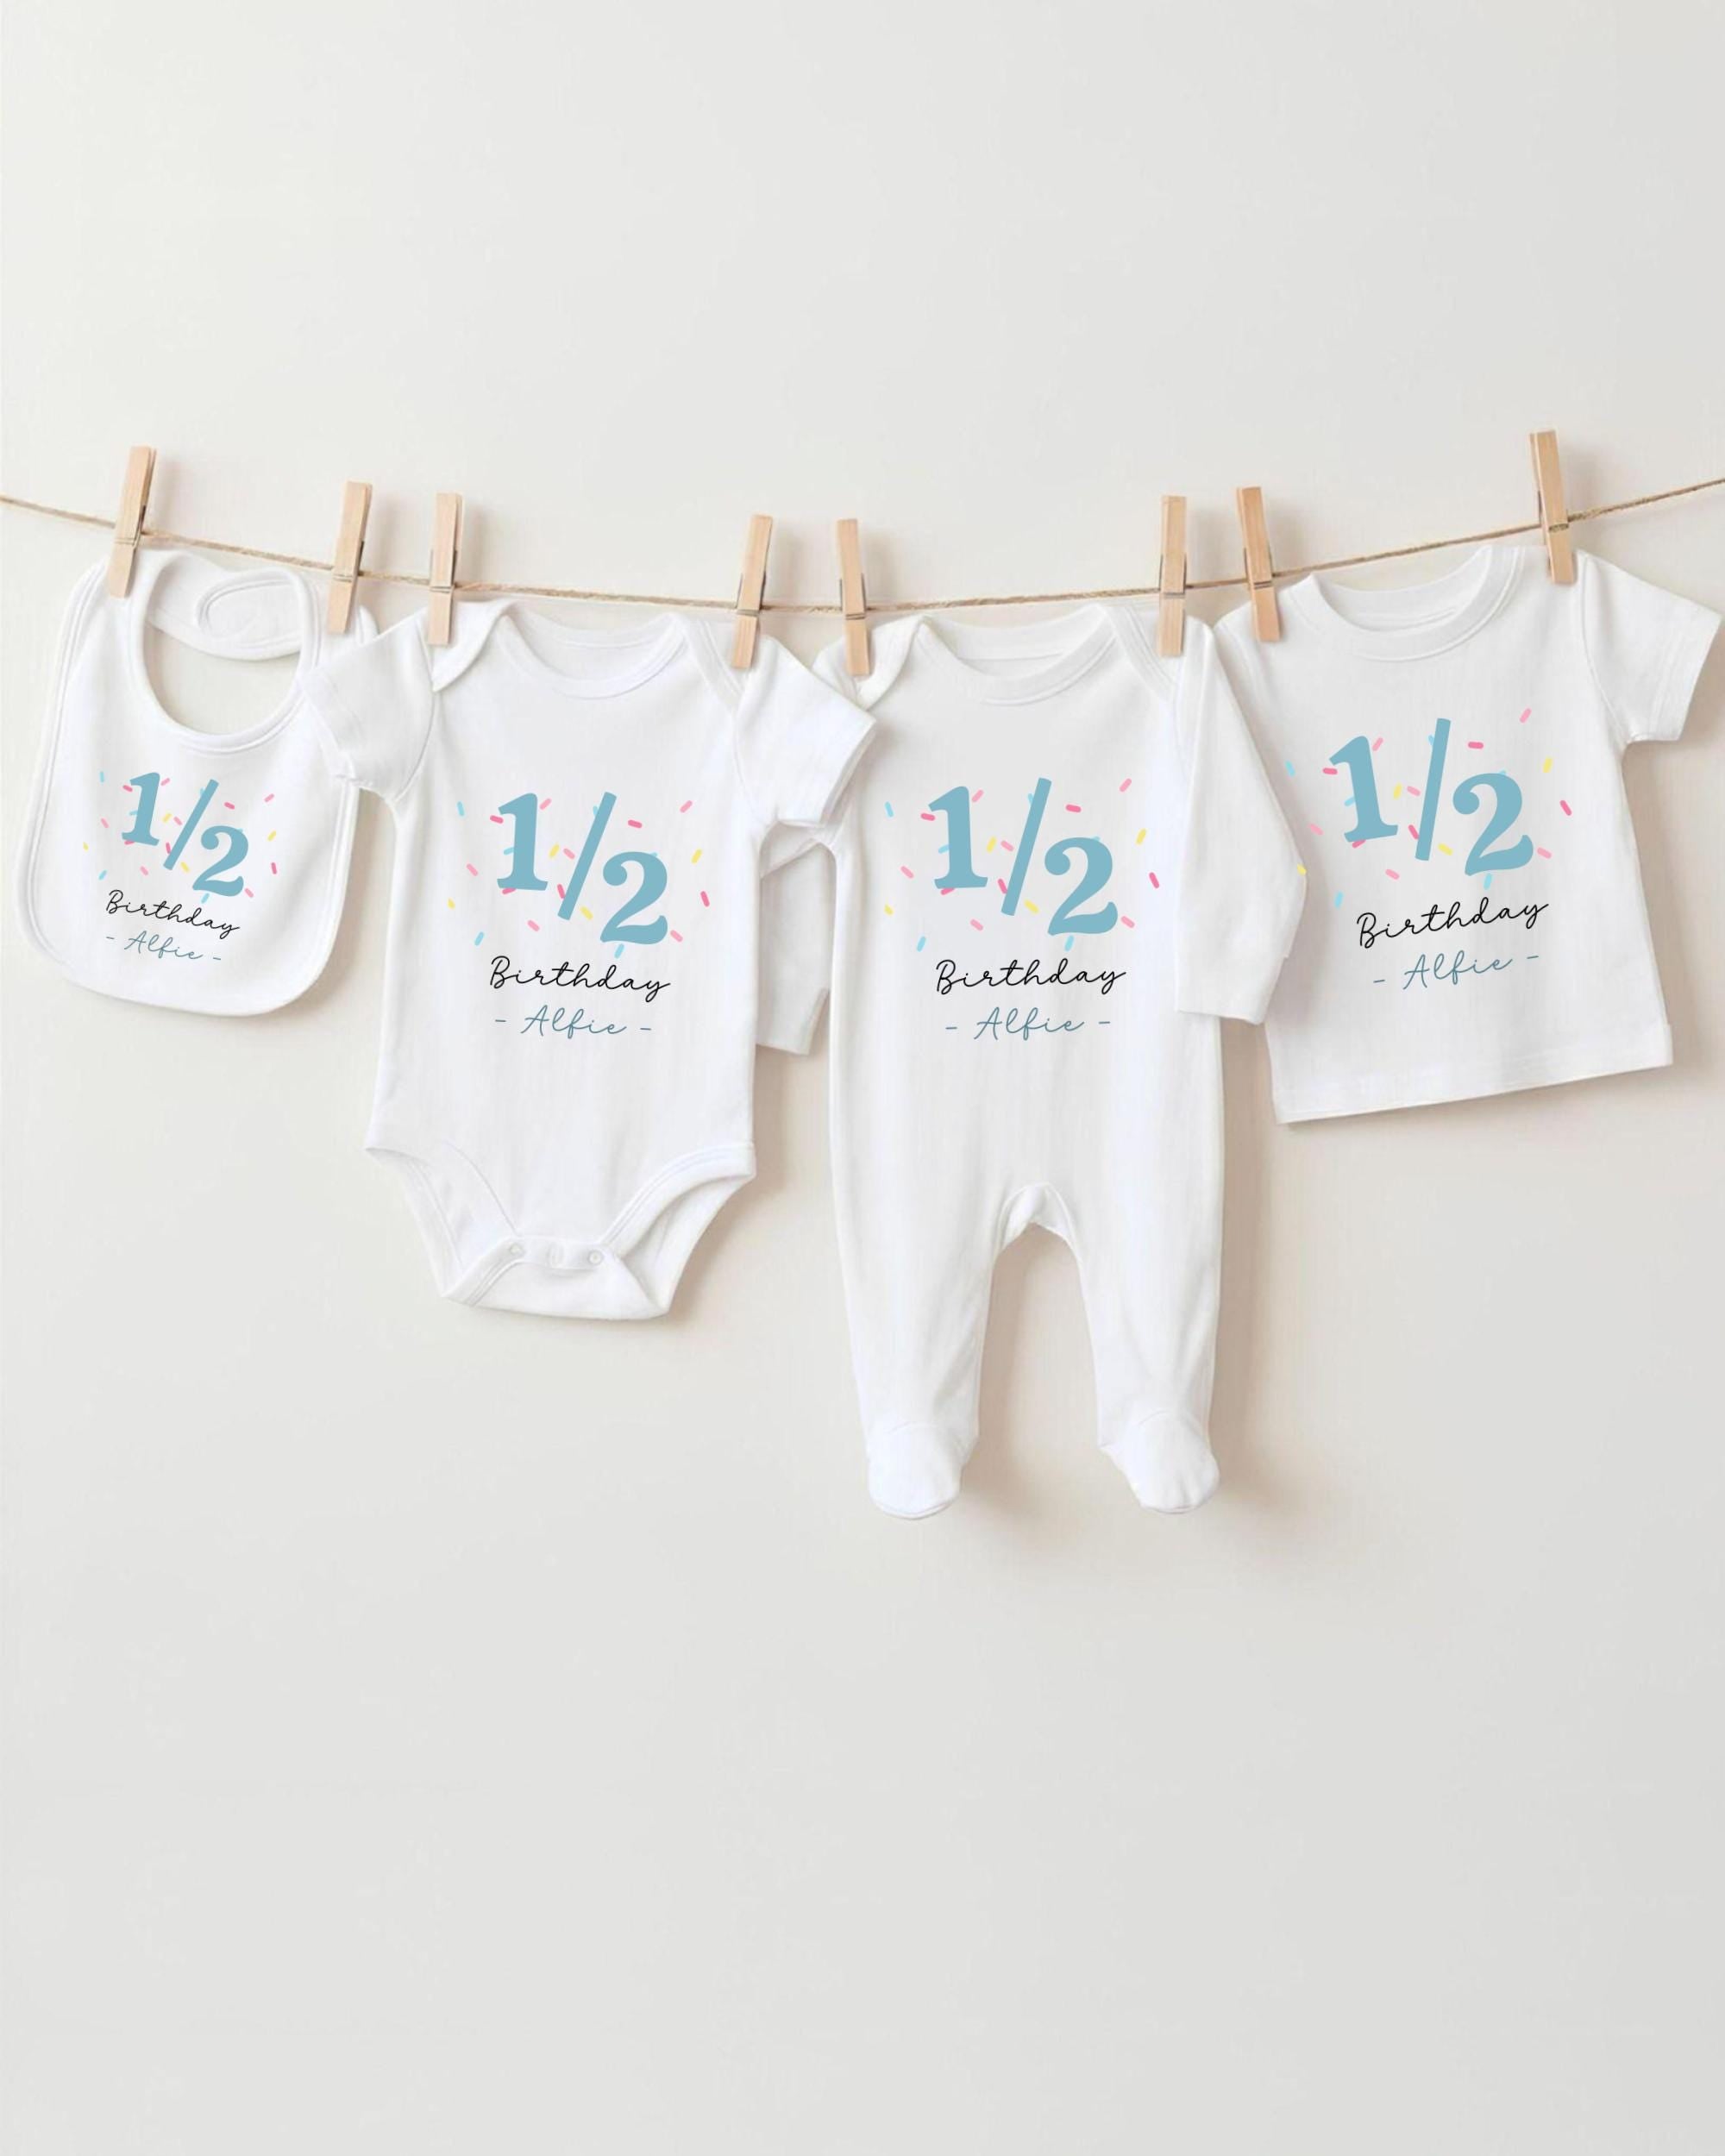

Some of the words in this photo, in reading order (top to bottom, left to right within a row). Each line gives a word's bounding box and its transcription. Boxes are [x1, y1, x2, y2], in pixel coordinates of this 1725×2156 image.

[1329, 718, 1534, 876] 1/2
[122, 773, 248, 896] 1/2
[929, 778, 1118, 937] 1/2
[497, 793, 668, 945] 1/2
[104, 889, 241, 940] Birthday
[1356, 896, 1549, 950] Birthday
[124, 931, 204, 959] Alfie
[489, 955, 671, 1003] Birthday
[935, 957, 1126, 995] Birthday
[1402, 950, 1515, 990] Alfie
[520, 1005, 627, 1039] Alfie
[974, 1006, 1085, 1041] Alfie
